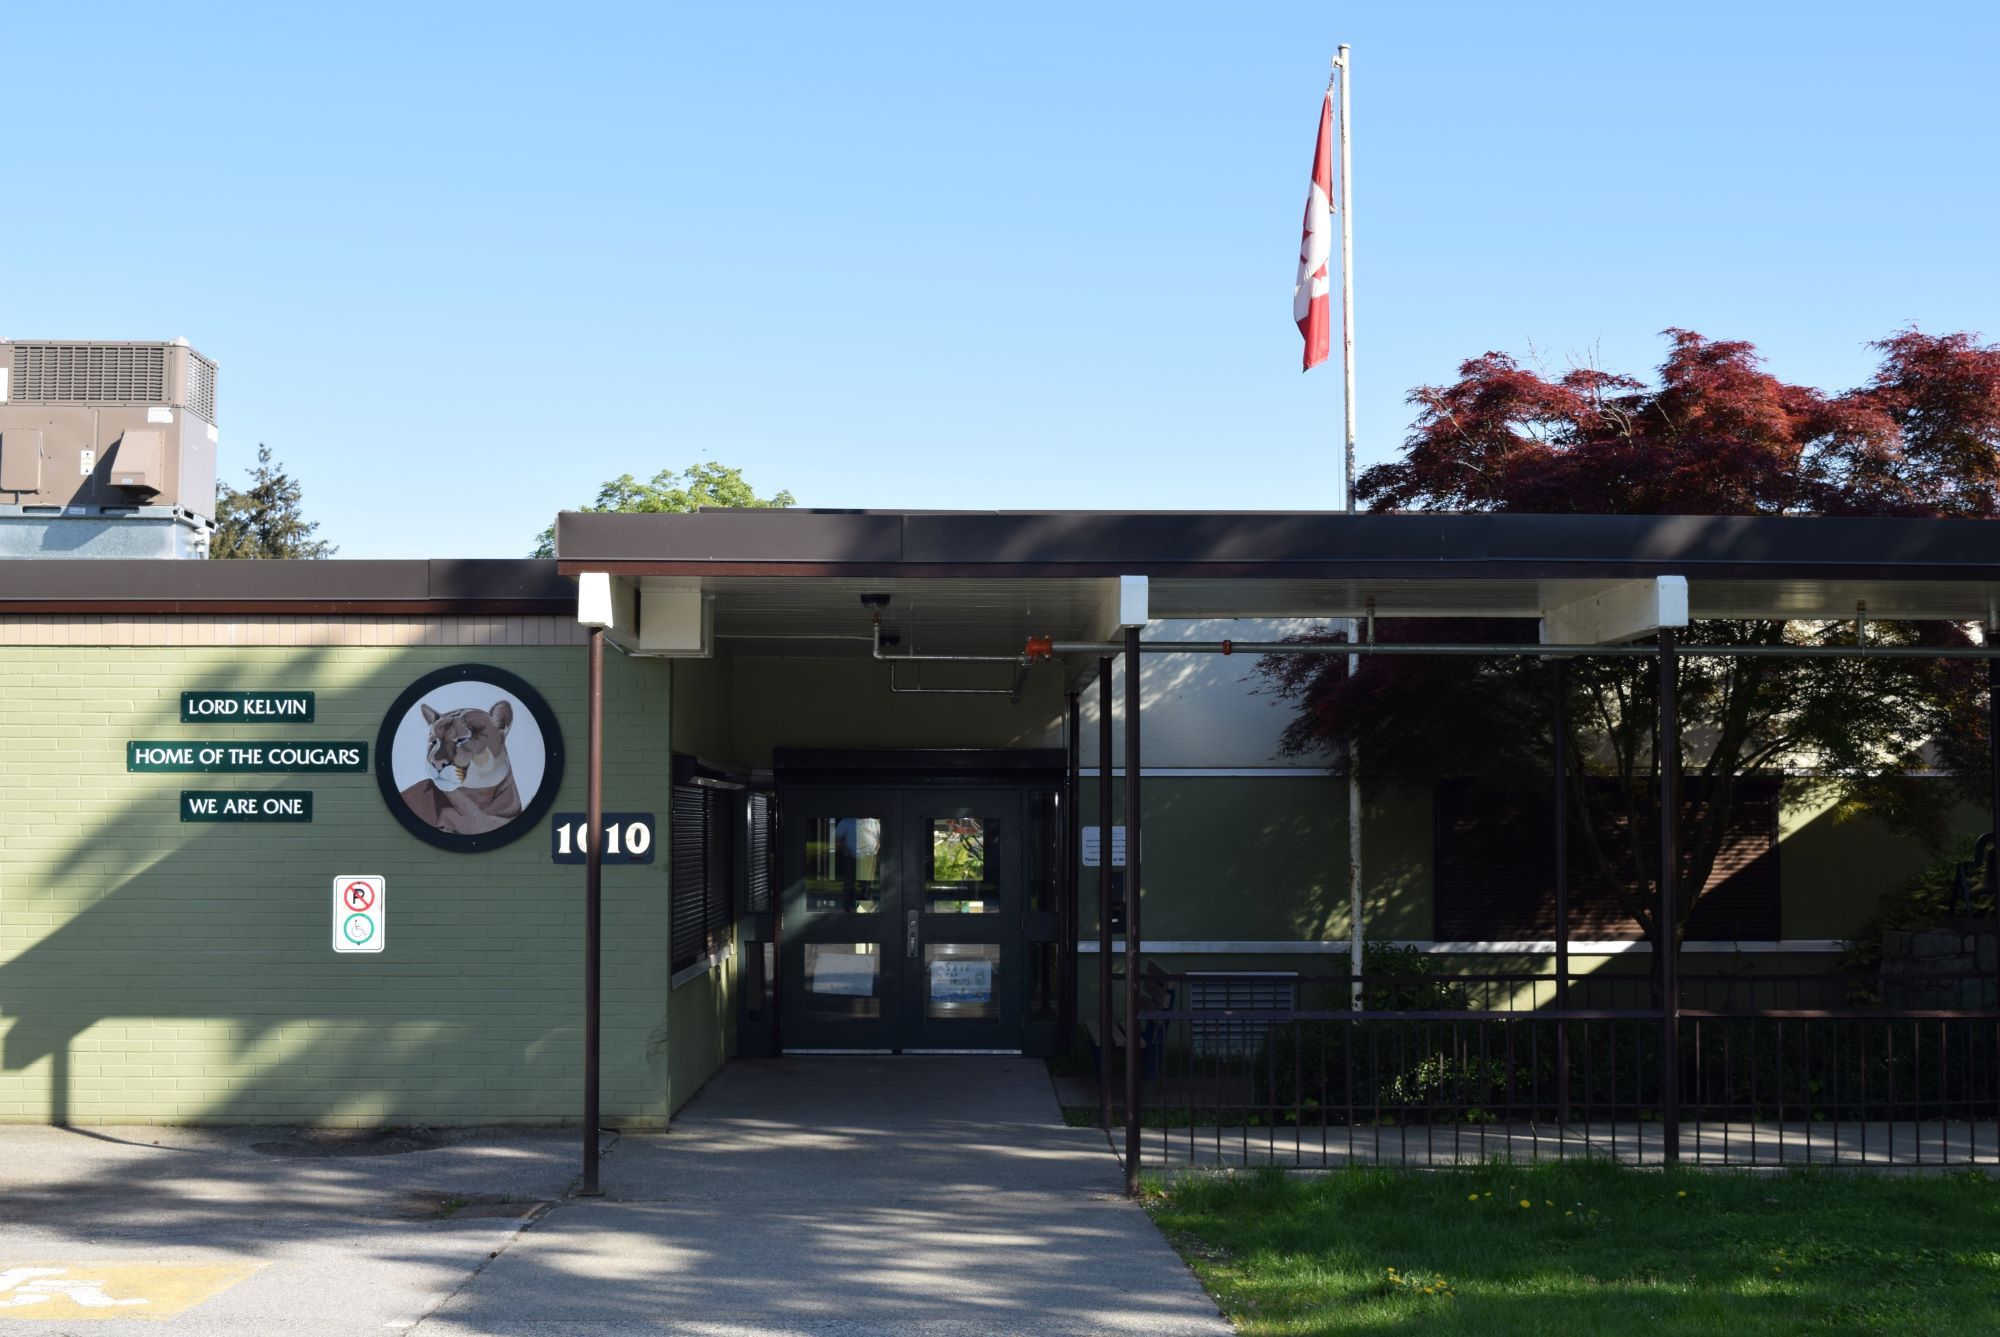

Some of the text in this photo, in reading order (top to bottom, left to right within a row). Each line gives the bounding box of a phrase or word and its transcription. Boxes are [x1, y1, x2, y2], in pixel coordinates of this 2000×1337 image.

[189, 699, 307, 715] LORD KELVIN
[134, 748, 360, 765] HOME OF THE COUGARS
[189, 798, 304, 814] WE ARE ONE
